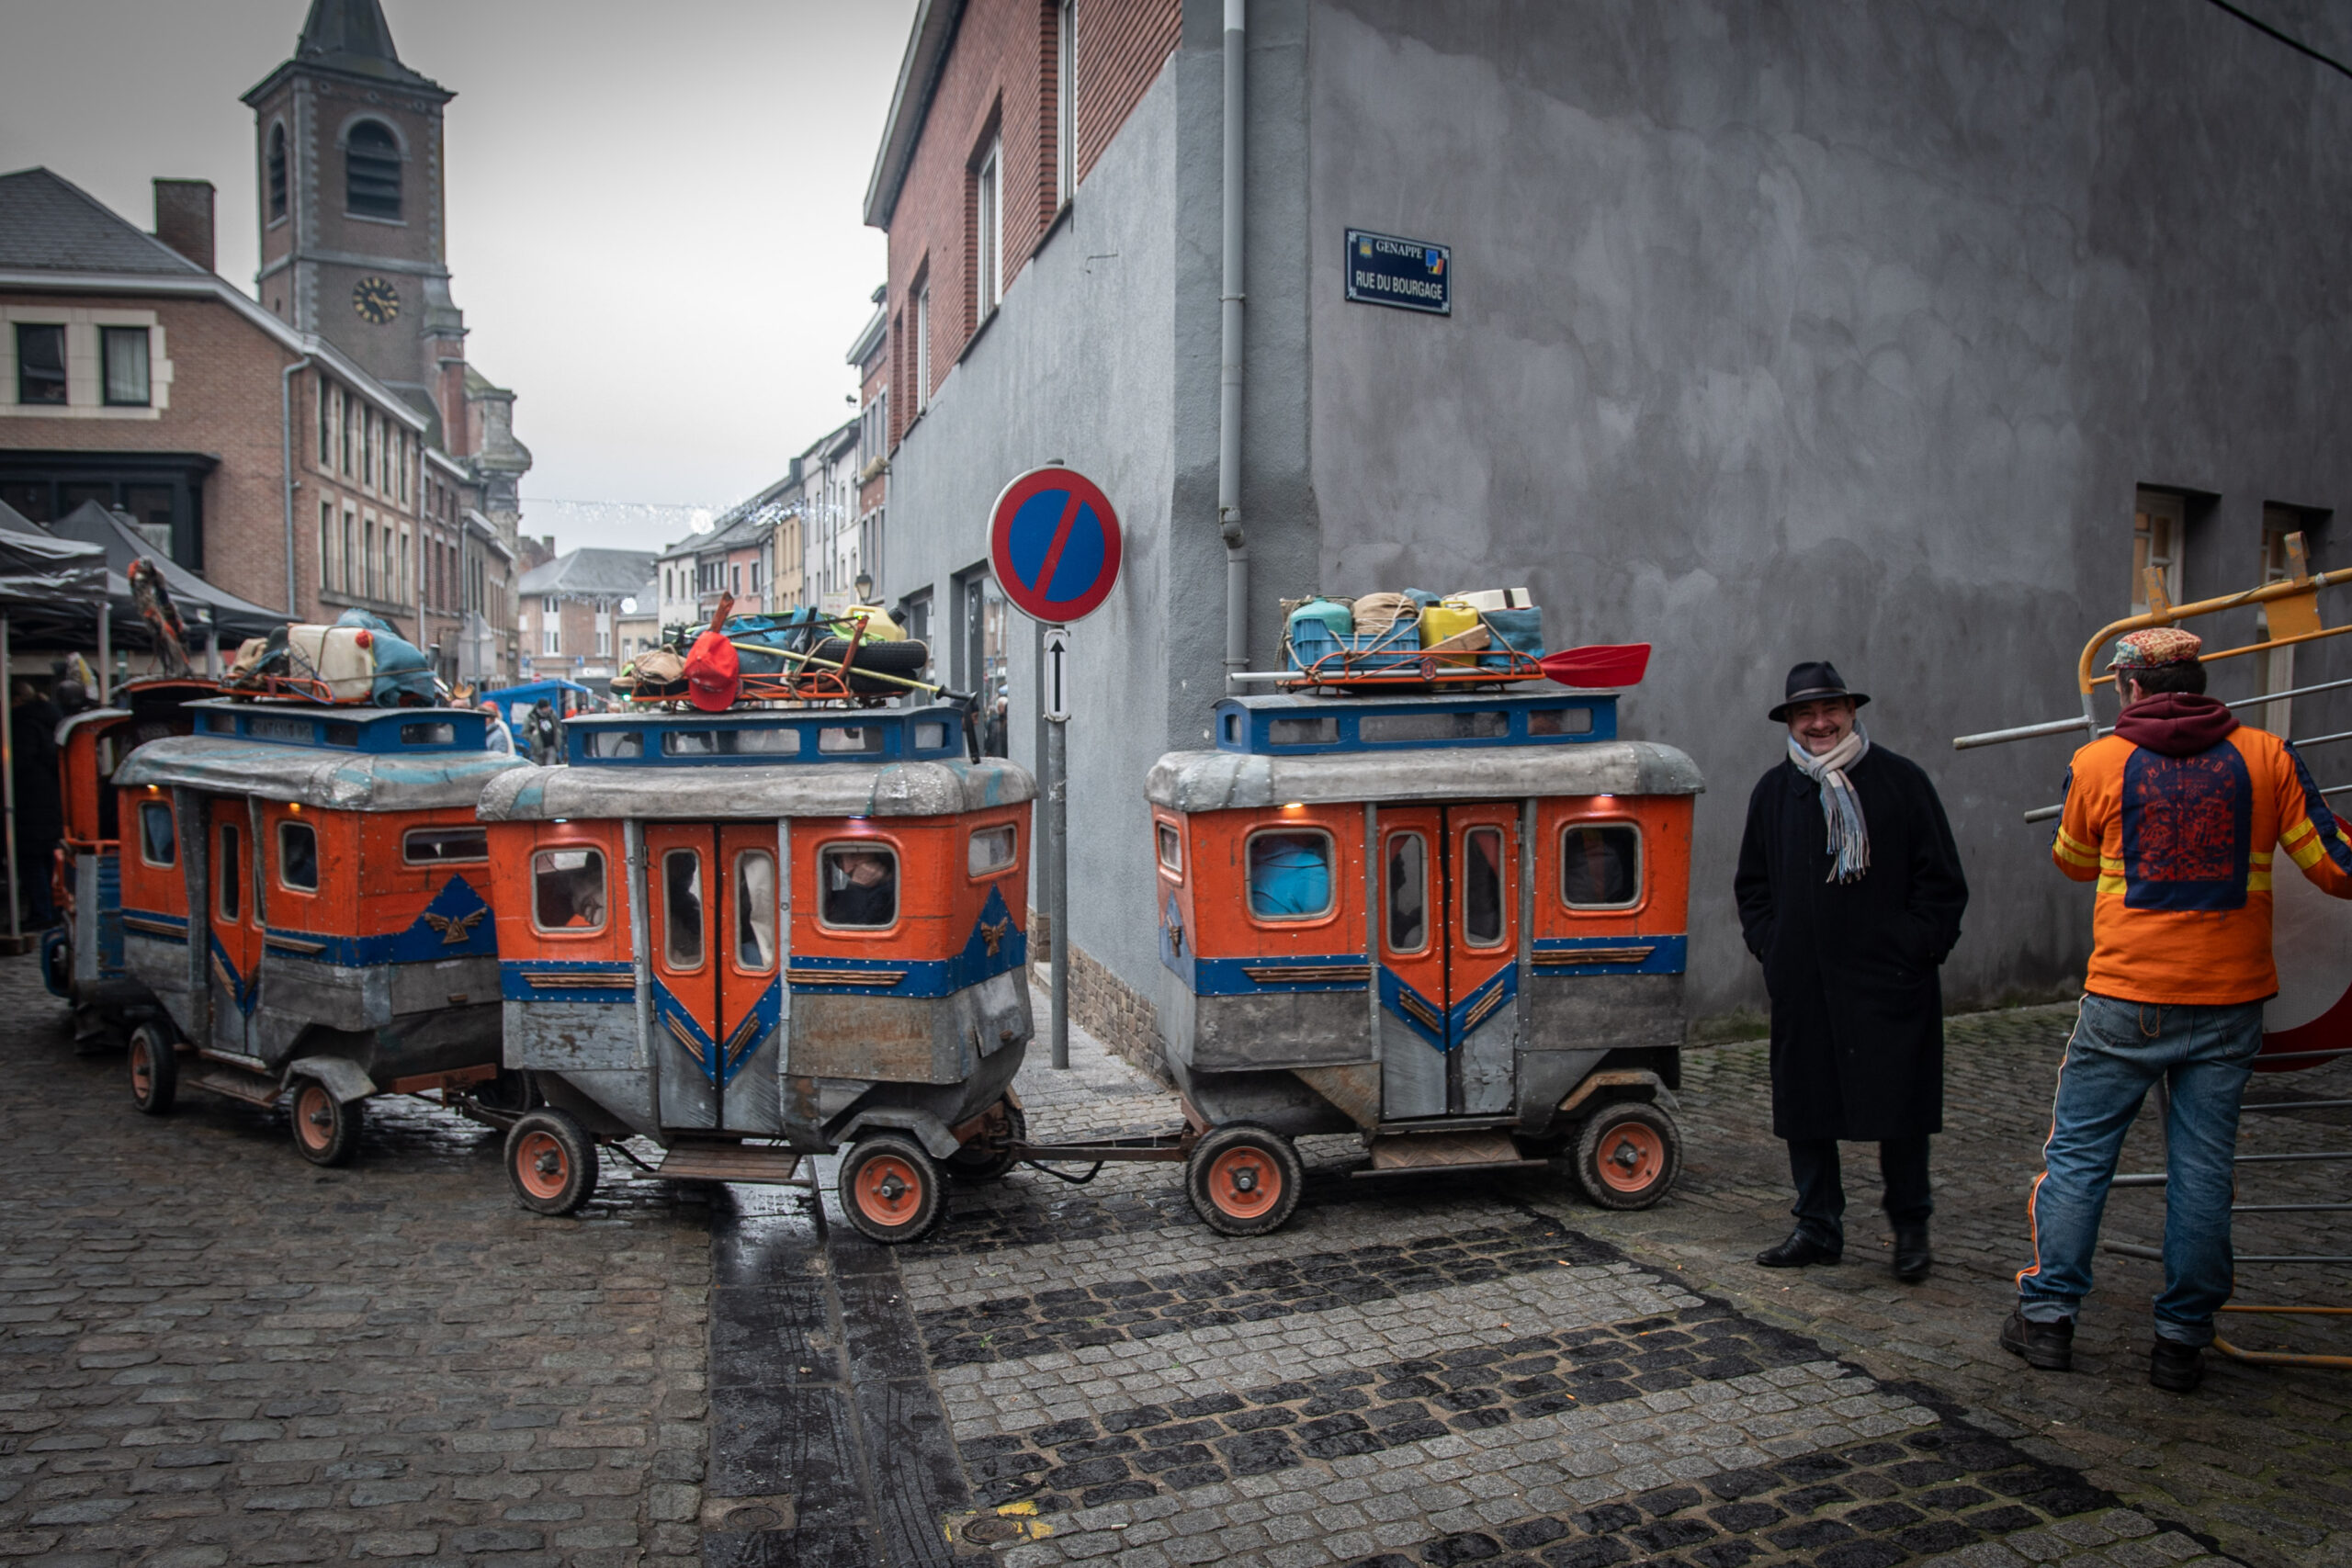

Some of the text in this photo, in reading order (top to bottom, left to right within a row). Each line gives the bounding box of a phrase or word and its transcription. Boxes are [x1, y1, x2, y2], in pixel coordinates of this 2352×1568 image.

[1376, 240, 1422, 259] GENAPPE
[1356, 270, 1442, 300] RUE DU BOURGAGE
